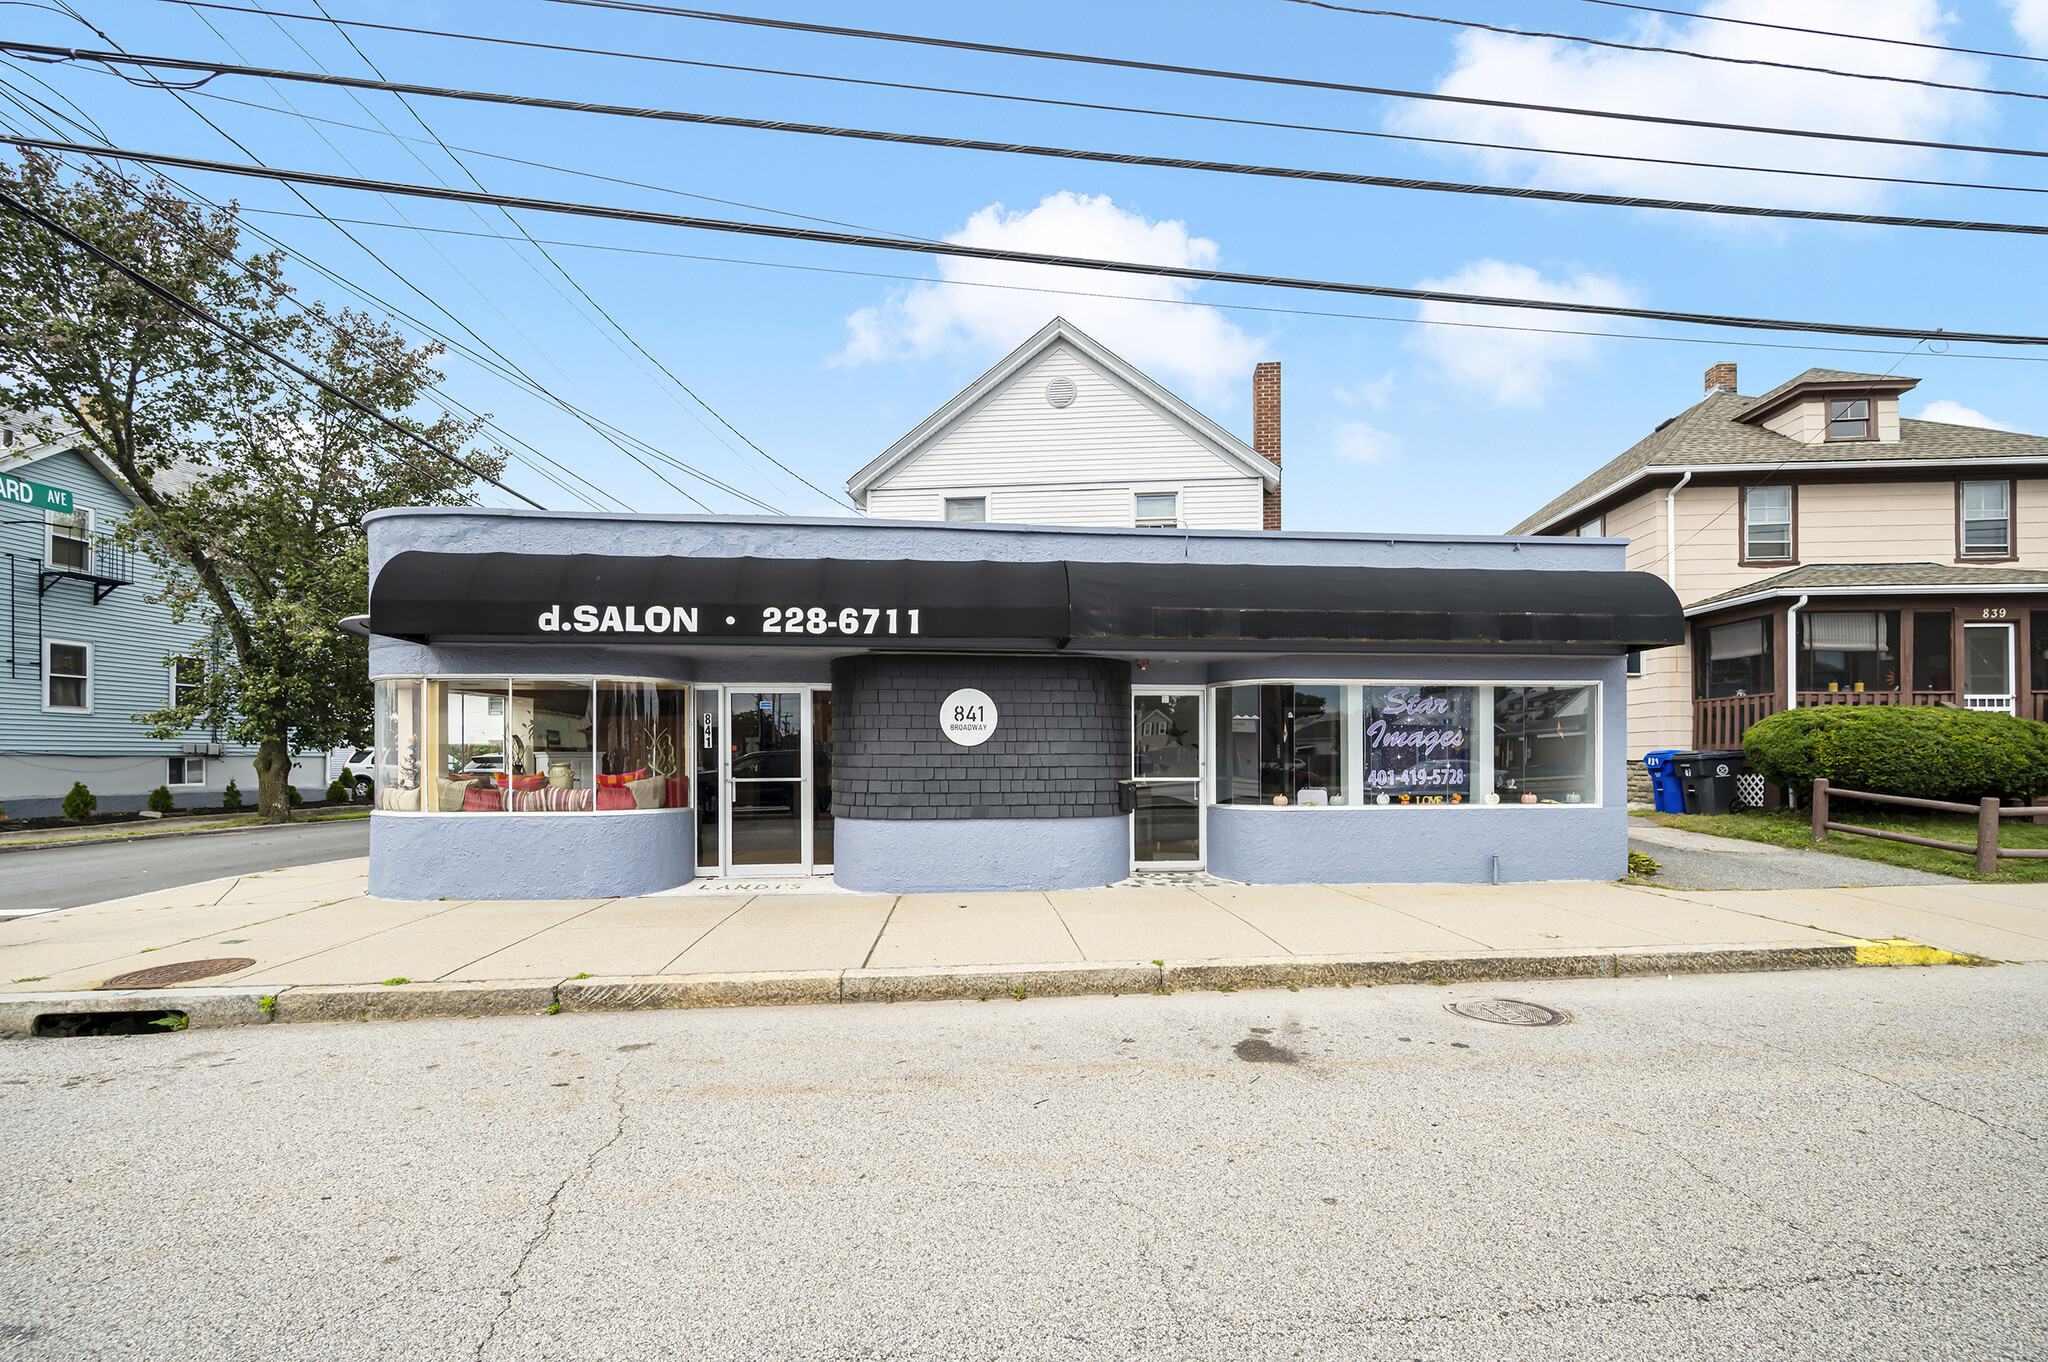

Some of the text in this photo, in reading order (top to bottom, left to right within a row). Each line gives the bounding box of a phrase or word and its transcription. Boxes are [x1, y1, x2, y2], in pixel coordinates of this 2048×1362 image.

[47, 489, 68, 507] AVE
[538, 605, 919, 635] d.SALON 228-6711
[1982, 608, 2007, 619] 839
[1383, 687, 1449, 715] Star
[954, 705, 984, 722] 841
[704, 713, 712, 748] 841
[1366, 719, 1465, 756] Images
[1367, 768, 1464, 786] 401-419-5728
[1416, 795, 1444, 806] LOVE
